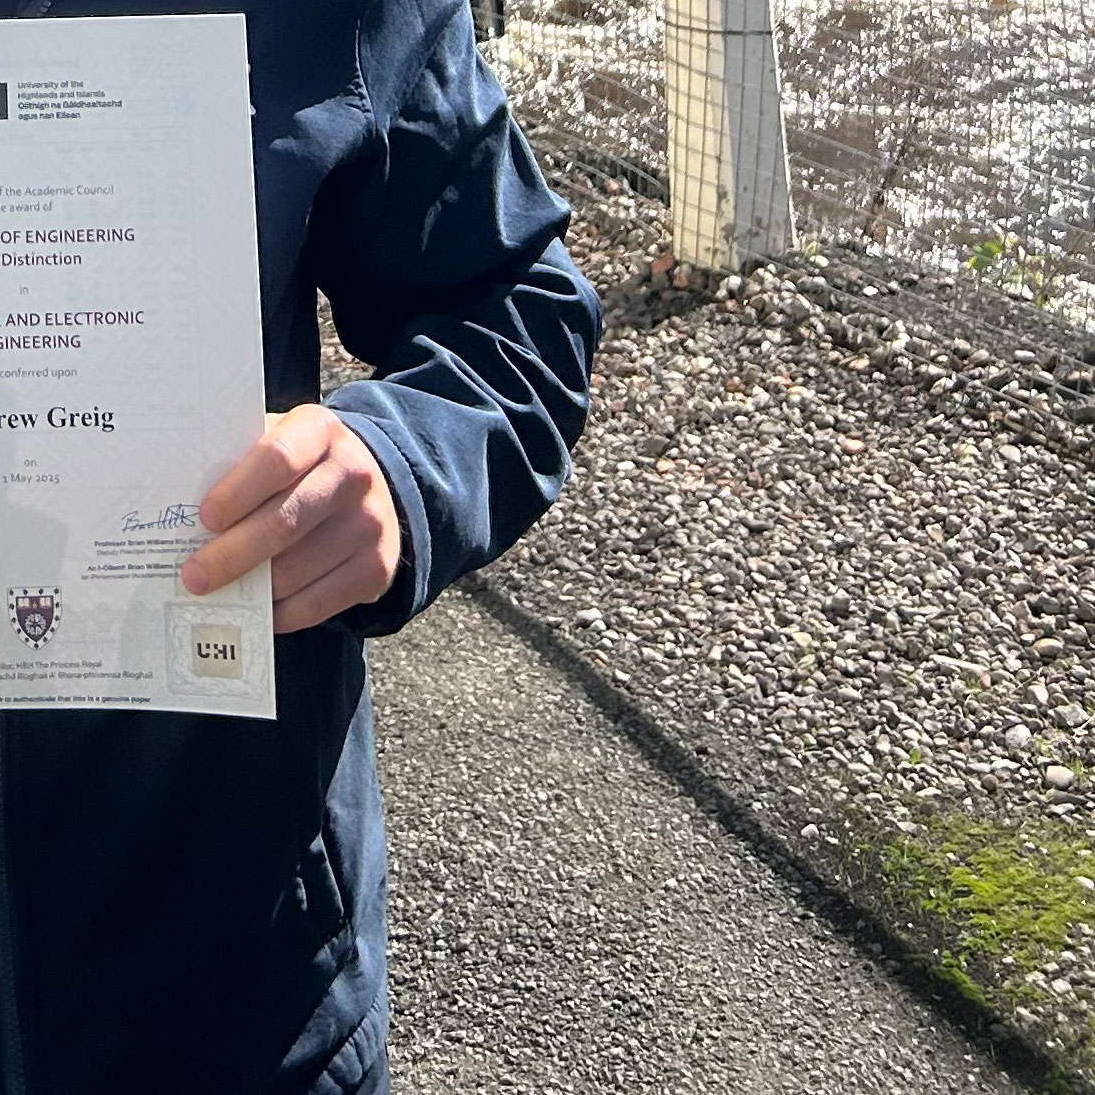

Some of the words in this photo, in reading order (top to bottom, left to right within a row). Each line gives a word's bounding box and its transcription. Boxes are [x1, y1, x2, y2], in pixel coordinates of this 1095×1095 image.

[18, 92, 57, 100] Highlands
[76, 90, 105, 98] Islands
[6, 187, 22, 196] the
[24, 186, 74, 196] Academic
[76, 184, 114, 195] Council
[9, 202, 40, 212] award
[42, 201, 53, 211] of
[0, 231, 21, 244] OF
[25, 228, 135, 244] ENGINEERING
[1, 251, 82, 266] Distinction
[20, 286, 29, 295] in
[5, 313, 41, 326] AND
[45, 310, 145, 326] ELECTRONIC
[0, 367, 48, 378] conferred
[51, 369, 78, 380] upon
[47, 406, 115, 432] Greig
[24, 459, 37, 467] on
[11, 473, 32, 484] May
[35, 475, 60, 484] 2025
[197, 643, 235, 660] UHI
[82, 660, 102, 668] Royal
